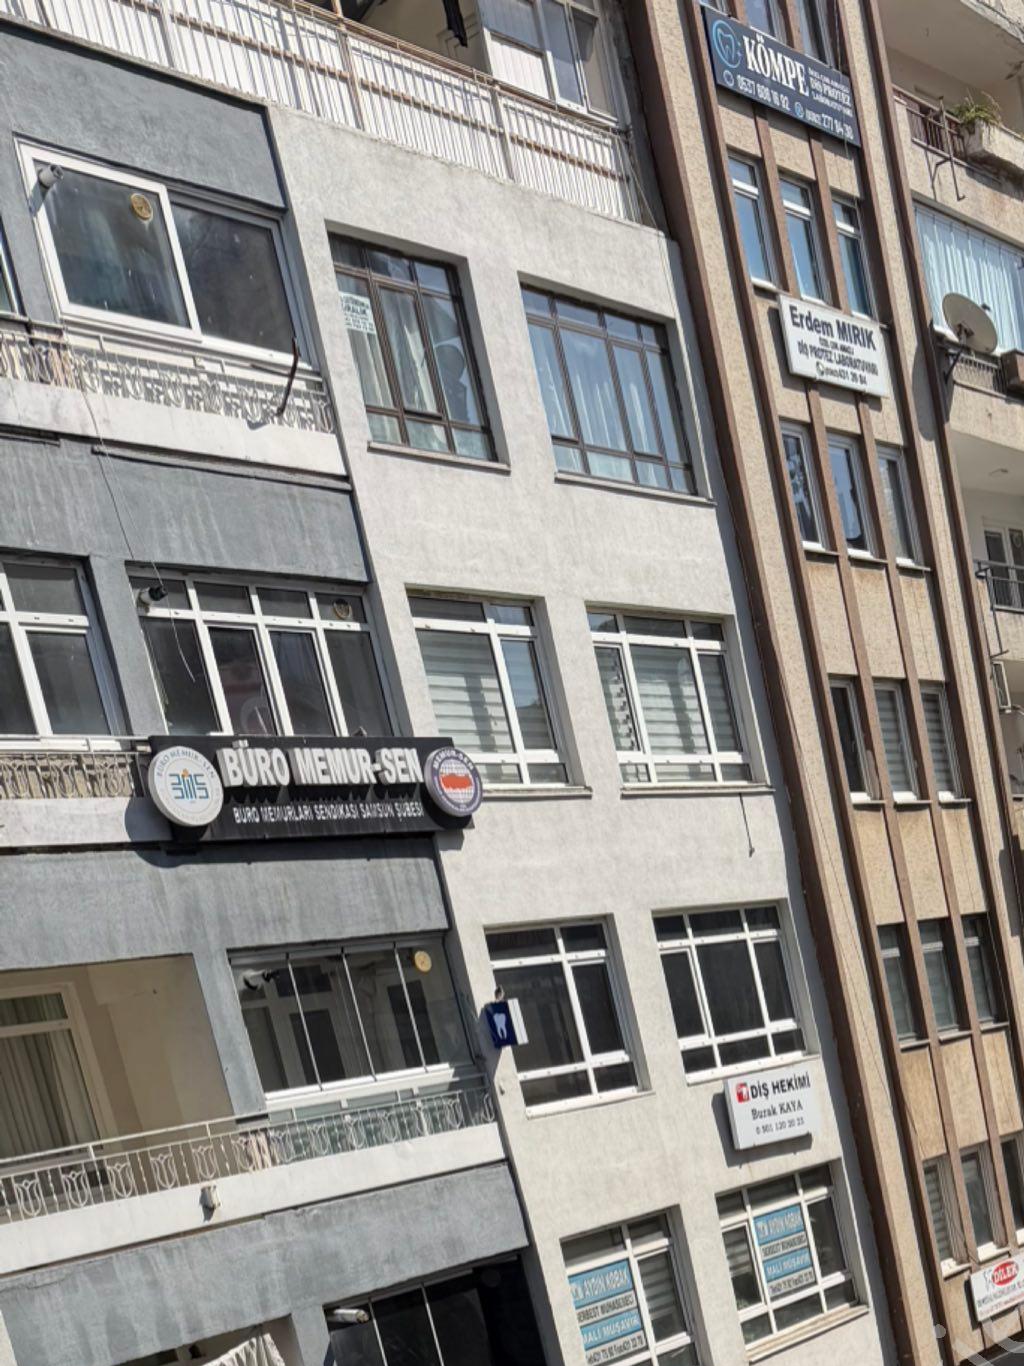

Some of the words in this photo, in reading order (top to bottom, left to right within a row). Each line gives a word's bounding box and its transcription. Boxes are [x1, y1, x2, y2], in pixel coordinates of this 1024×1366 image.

[743, 34, 809, 97] KÖMPE
[789, 305, 834, 341] Erdem
[217, 740, 290, 787] BÜRO
[289, 747, 424, 786] MEMUR-SEN
[750, 1081, 770, 1100] DİŞ
[771, 1072, 811, 1095] HEKİMİ
[751, 1104, 777, 1120] Burak
[779, 1100, 803, 1114] KAYA
